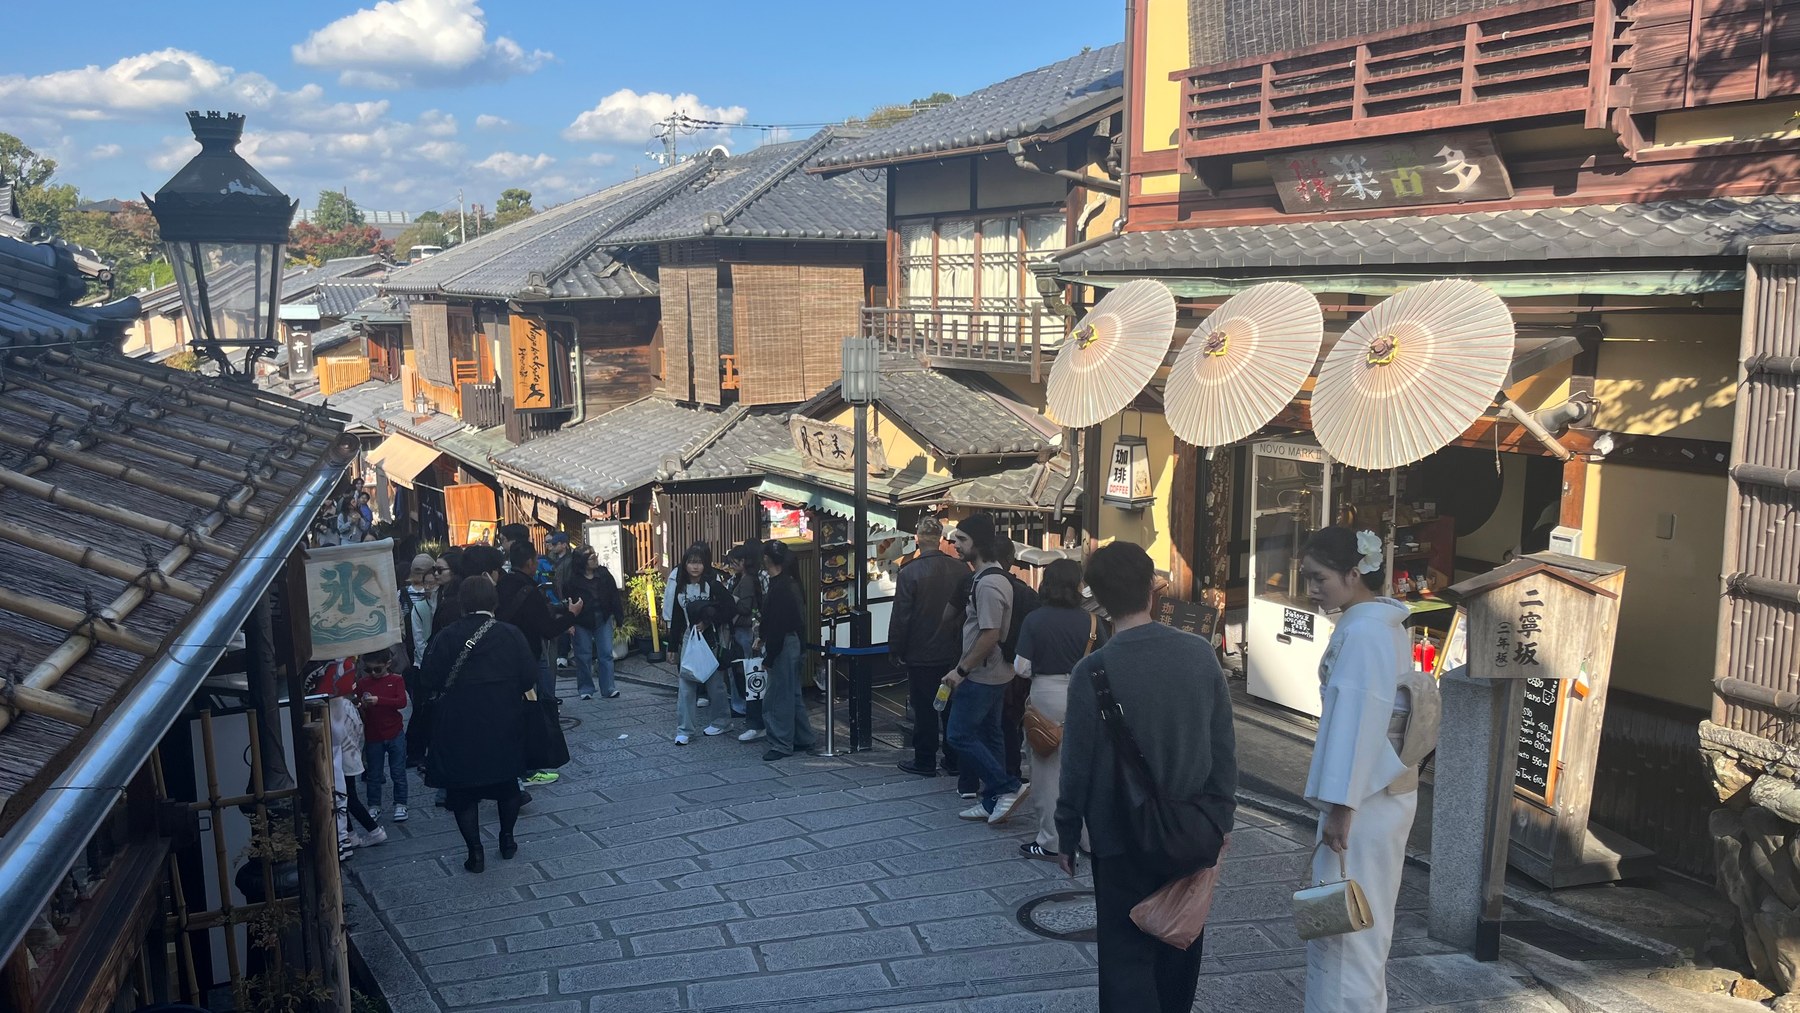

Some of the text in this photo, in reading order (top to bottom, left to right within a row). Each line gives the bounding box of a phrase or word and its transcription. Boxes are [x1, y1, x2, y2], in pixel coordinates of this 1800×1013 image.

[800, 425, 870, 464] 月下美
[1259, 443, 1285, 455] NOVO
[1288, 446, 1314, 458] MARK
[1113, 449, 1128, 483] 珈琲
[1109, 484, 1129, 495] COFFEE
[319, 561, 381, 615] 氷
[1160, 602, 1175, 626] 珈琲
[1513, 589, 1544, 666] 二寧坂
